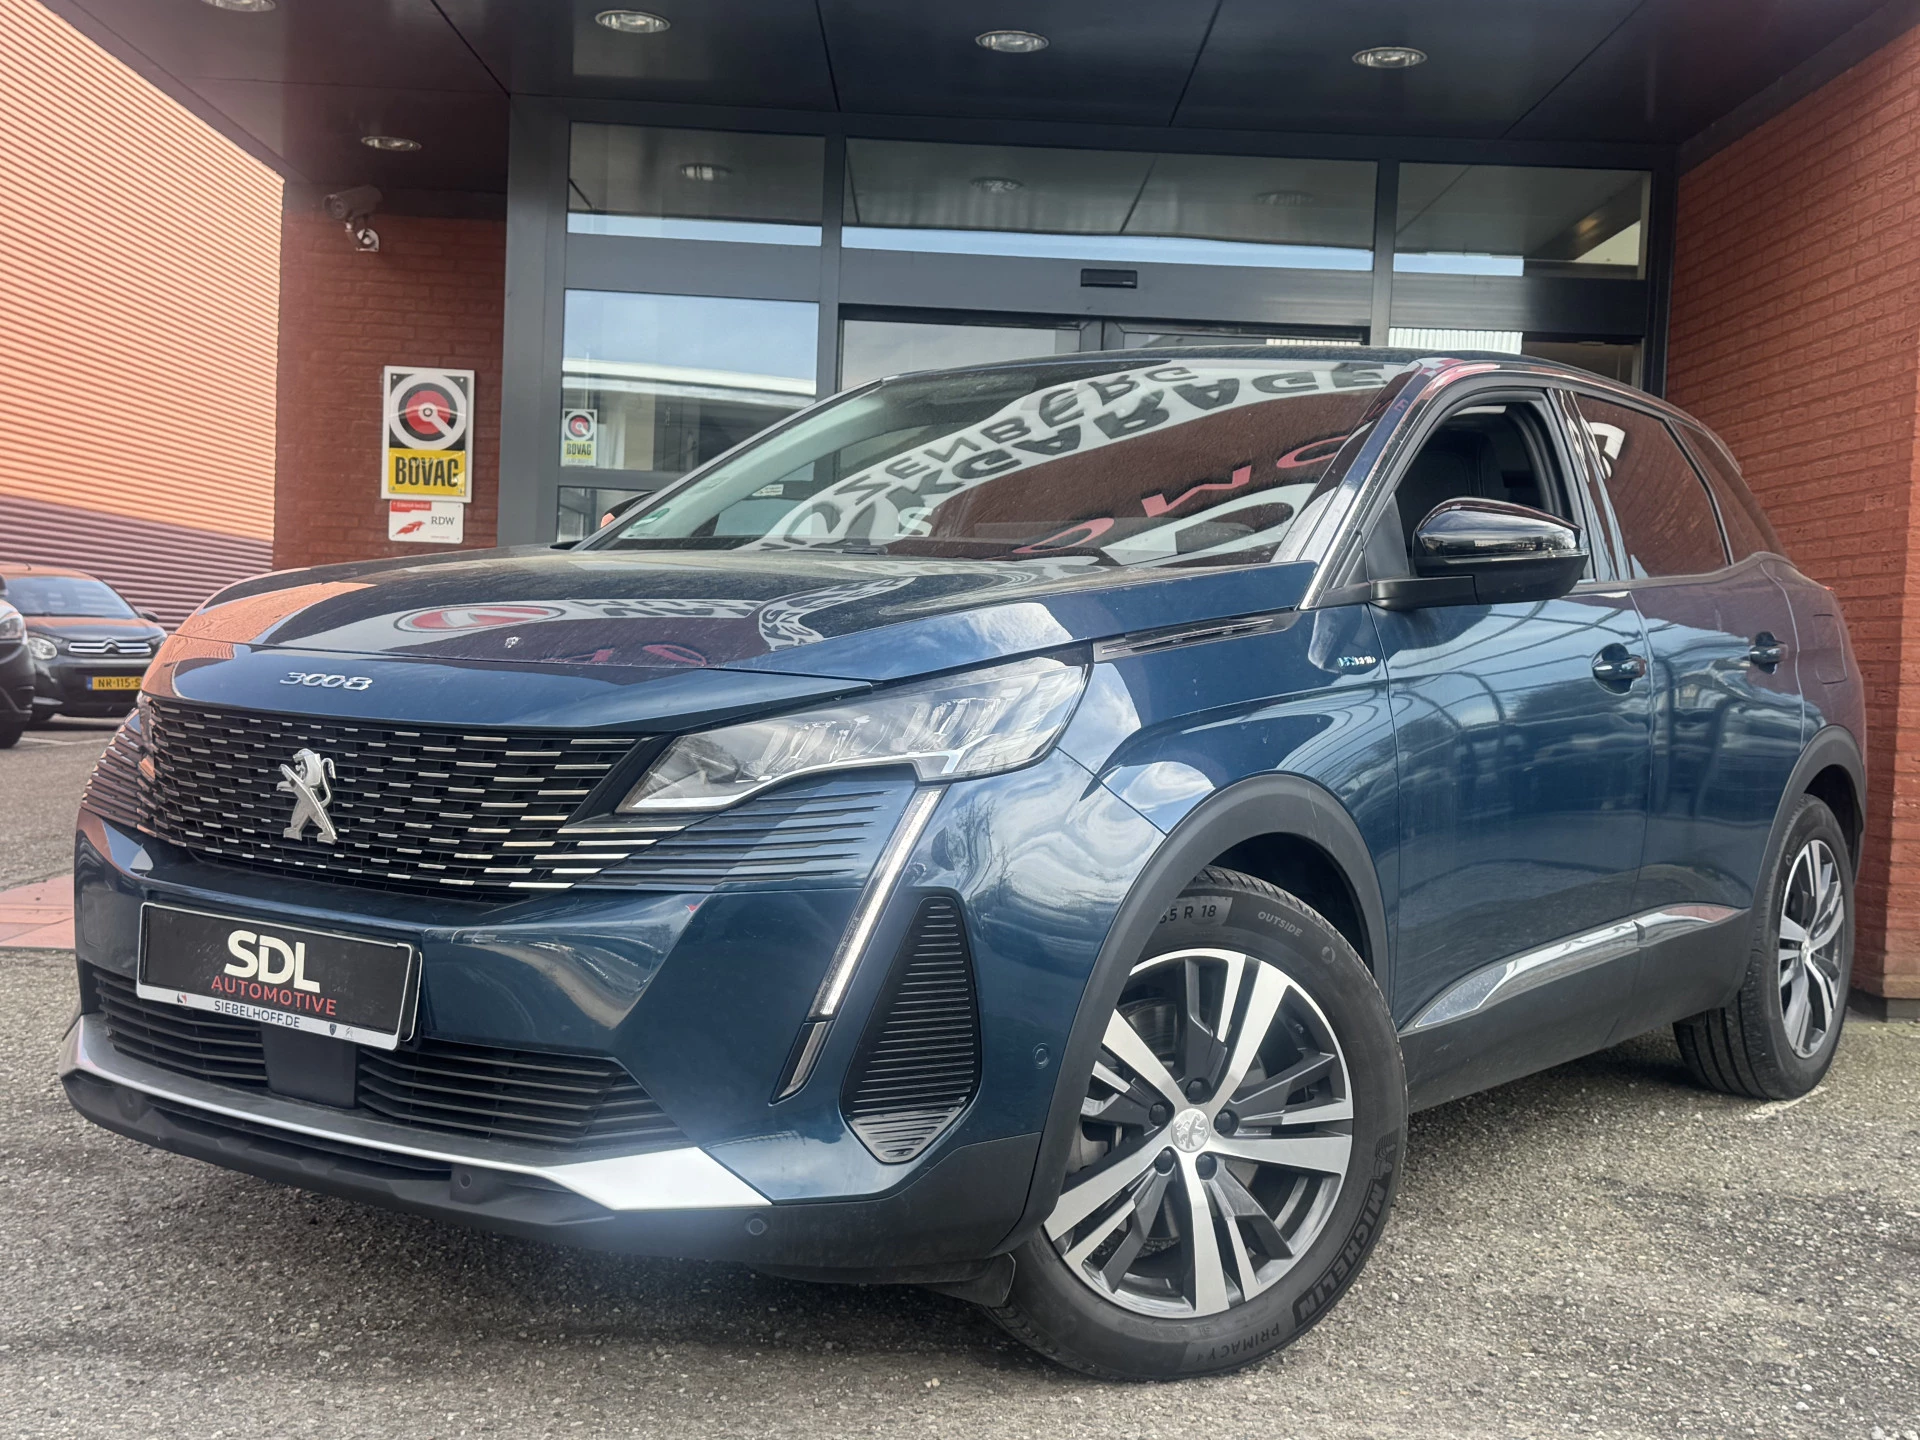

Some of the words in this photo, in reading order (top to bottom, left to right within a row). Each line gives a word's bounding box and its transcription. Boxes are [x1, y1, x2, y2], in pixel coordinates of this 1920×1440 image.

[566, 443, 592, 456] BOVAG
[395, 456, 459, 487] BOVAG
[430, 516, 455, 526] RDW
[279, 672, 373, 692] 3008
[1184, 905, 1195, 919] R
[1201, 904, 1217, 918] 18
[1257, 911, 1303, 937] OUTSIDE
[223, 929, 321, 994] SDL
[211, 975, 337, 1016] AUTOMOTIVE
[214, 1000, 300, 1028] SIEBELHOFF.DE
[1297, 1184, 1388, 1323] MICHELIN
[1207, 1323, 1280, 1362] PRIMACY
